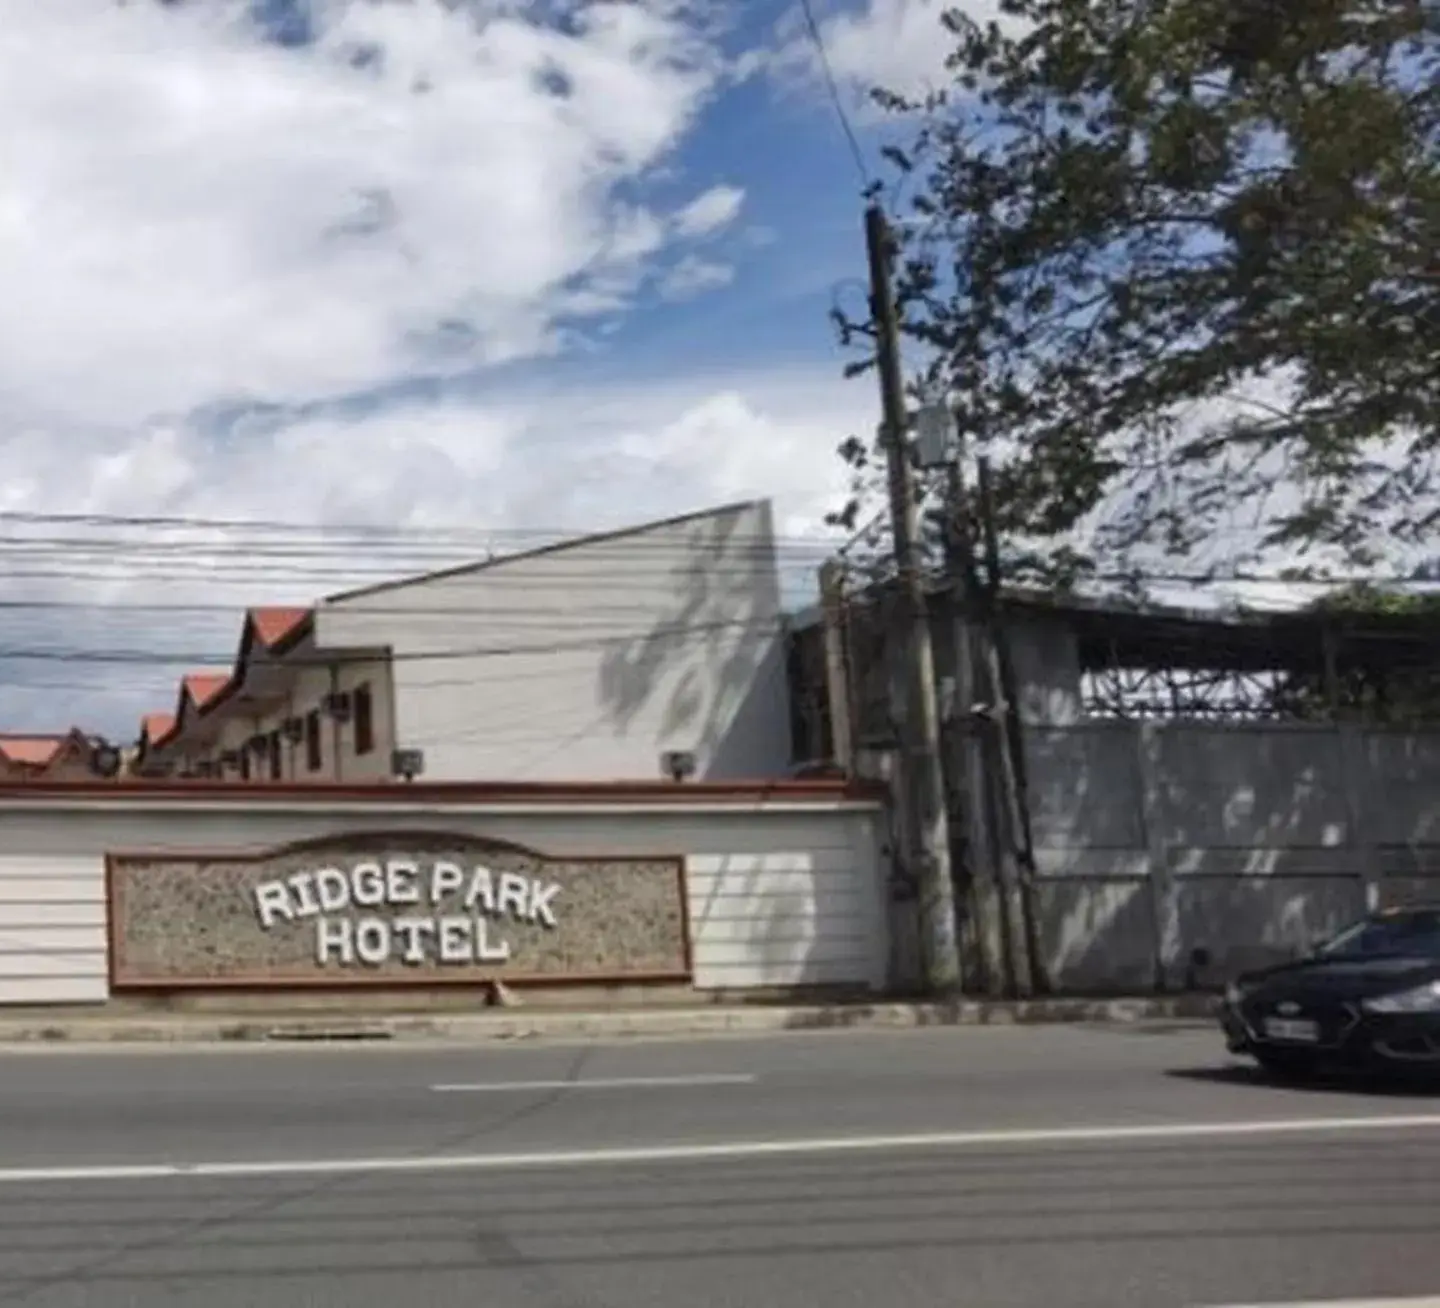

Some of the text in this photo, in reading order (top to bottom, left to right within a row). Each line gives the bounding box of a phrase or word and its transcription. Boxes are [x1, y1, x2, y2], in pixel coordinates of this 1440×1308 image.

[255, 860, 561, 928] RIDGE PARK
[317, 917, 510, 965] HOTEL
